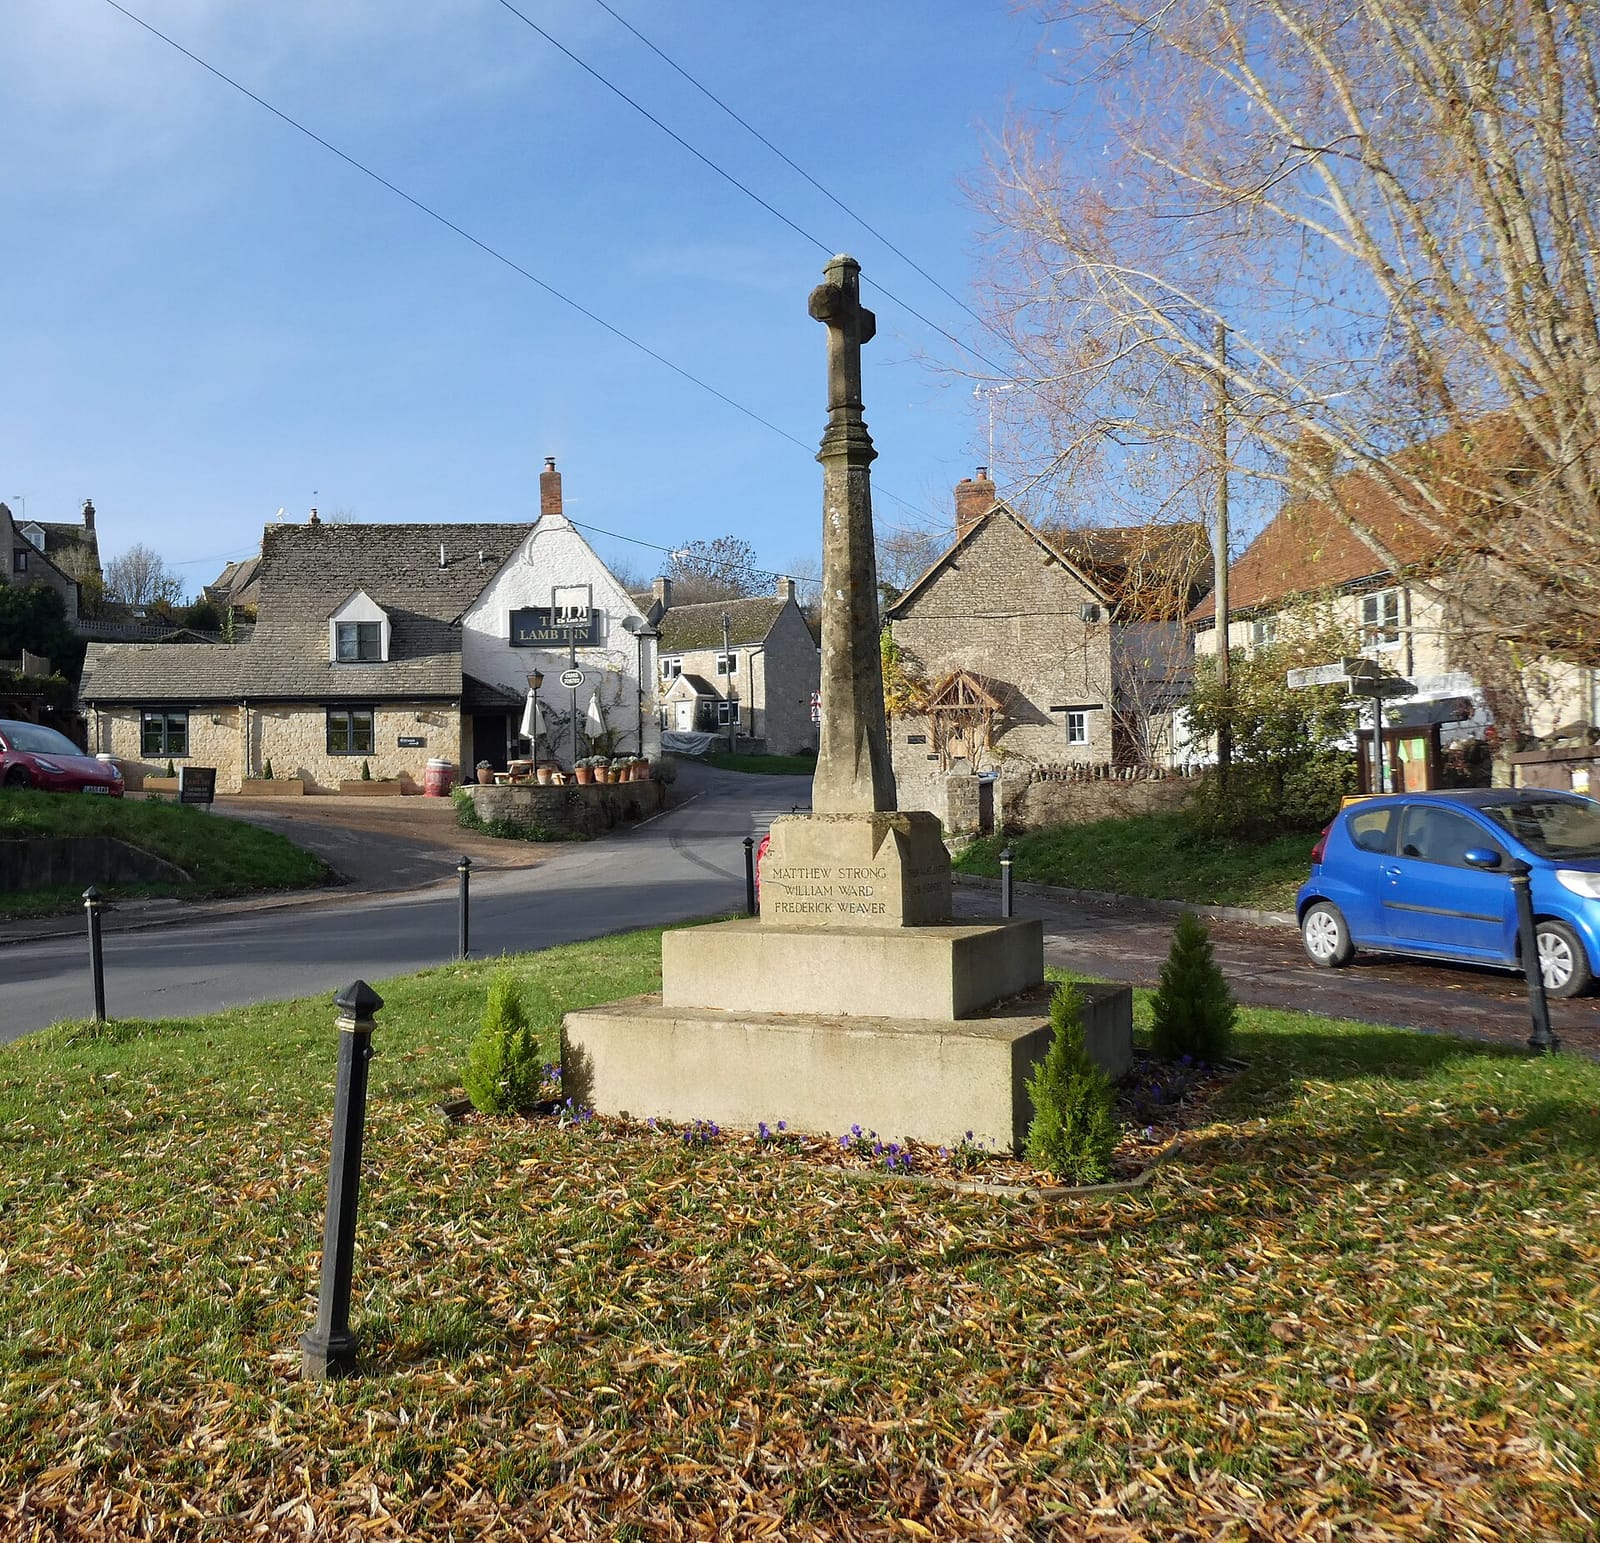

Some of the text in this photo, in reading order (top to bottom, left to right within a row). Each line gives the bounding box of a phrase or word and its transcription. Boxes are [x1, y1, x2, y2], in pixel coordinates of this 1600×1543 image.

[519, 629, 559, 640] LAMB
[772, 867, 887, 879] MATTHEW STRONG
[785, 885, 874, 896] WILLIAM WARD
[775, 902, 886, 914] FREDERICK WEAVER
